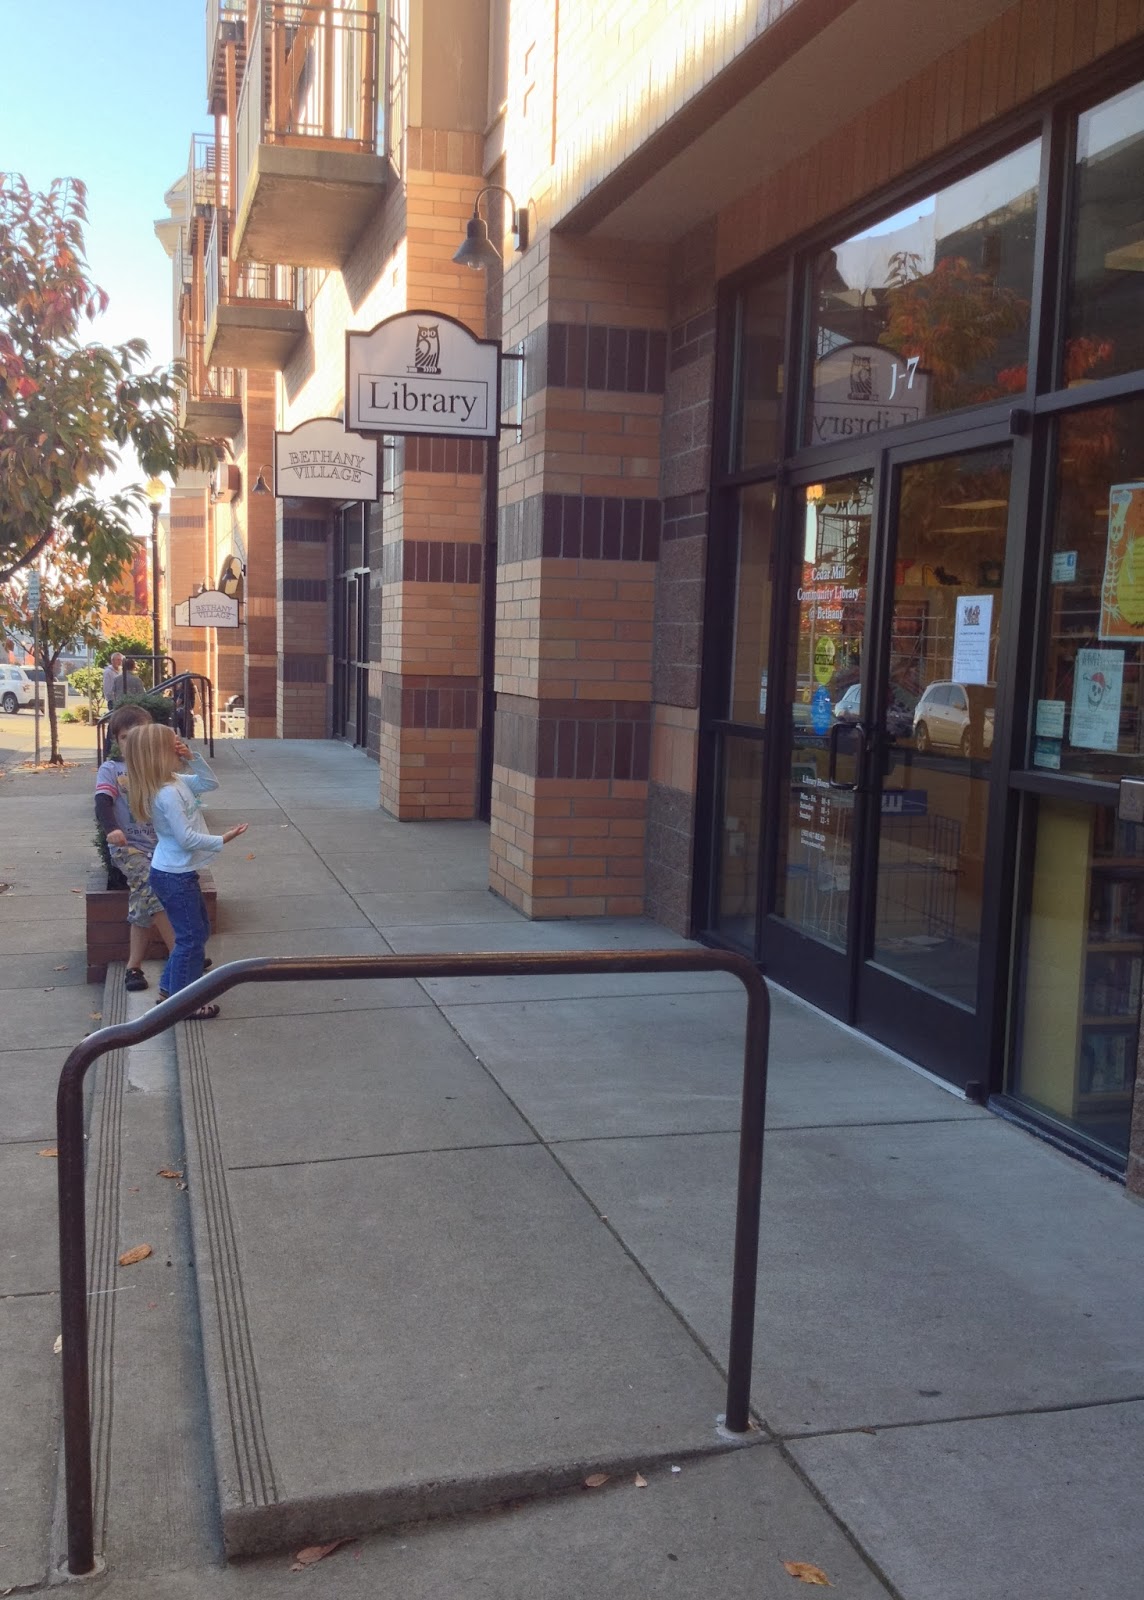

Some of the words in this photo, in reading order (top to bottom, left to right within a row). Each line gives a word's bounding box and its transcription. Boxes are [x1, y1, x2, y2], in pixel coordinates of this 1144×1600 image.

[888, 356, 920, 400] J-7
[368, 380, 478, 422] Library
[288, 449, 366, 469] BETHANY
[293, 467, 362, 483] VILLAGE
[811, 567, 831, 581] Cedar
[831, 565, 846, 579] Mill
[797, 588, 834, 602] Community
[834, 586, 860, 601] Library
[196, 604, 233, 612] BETHANY
[198, 612, 232, 620] VILLAGE
[817, 606, 844, 622] Bethany
